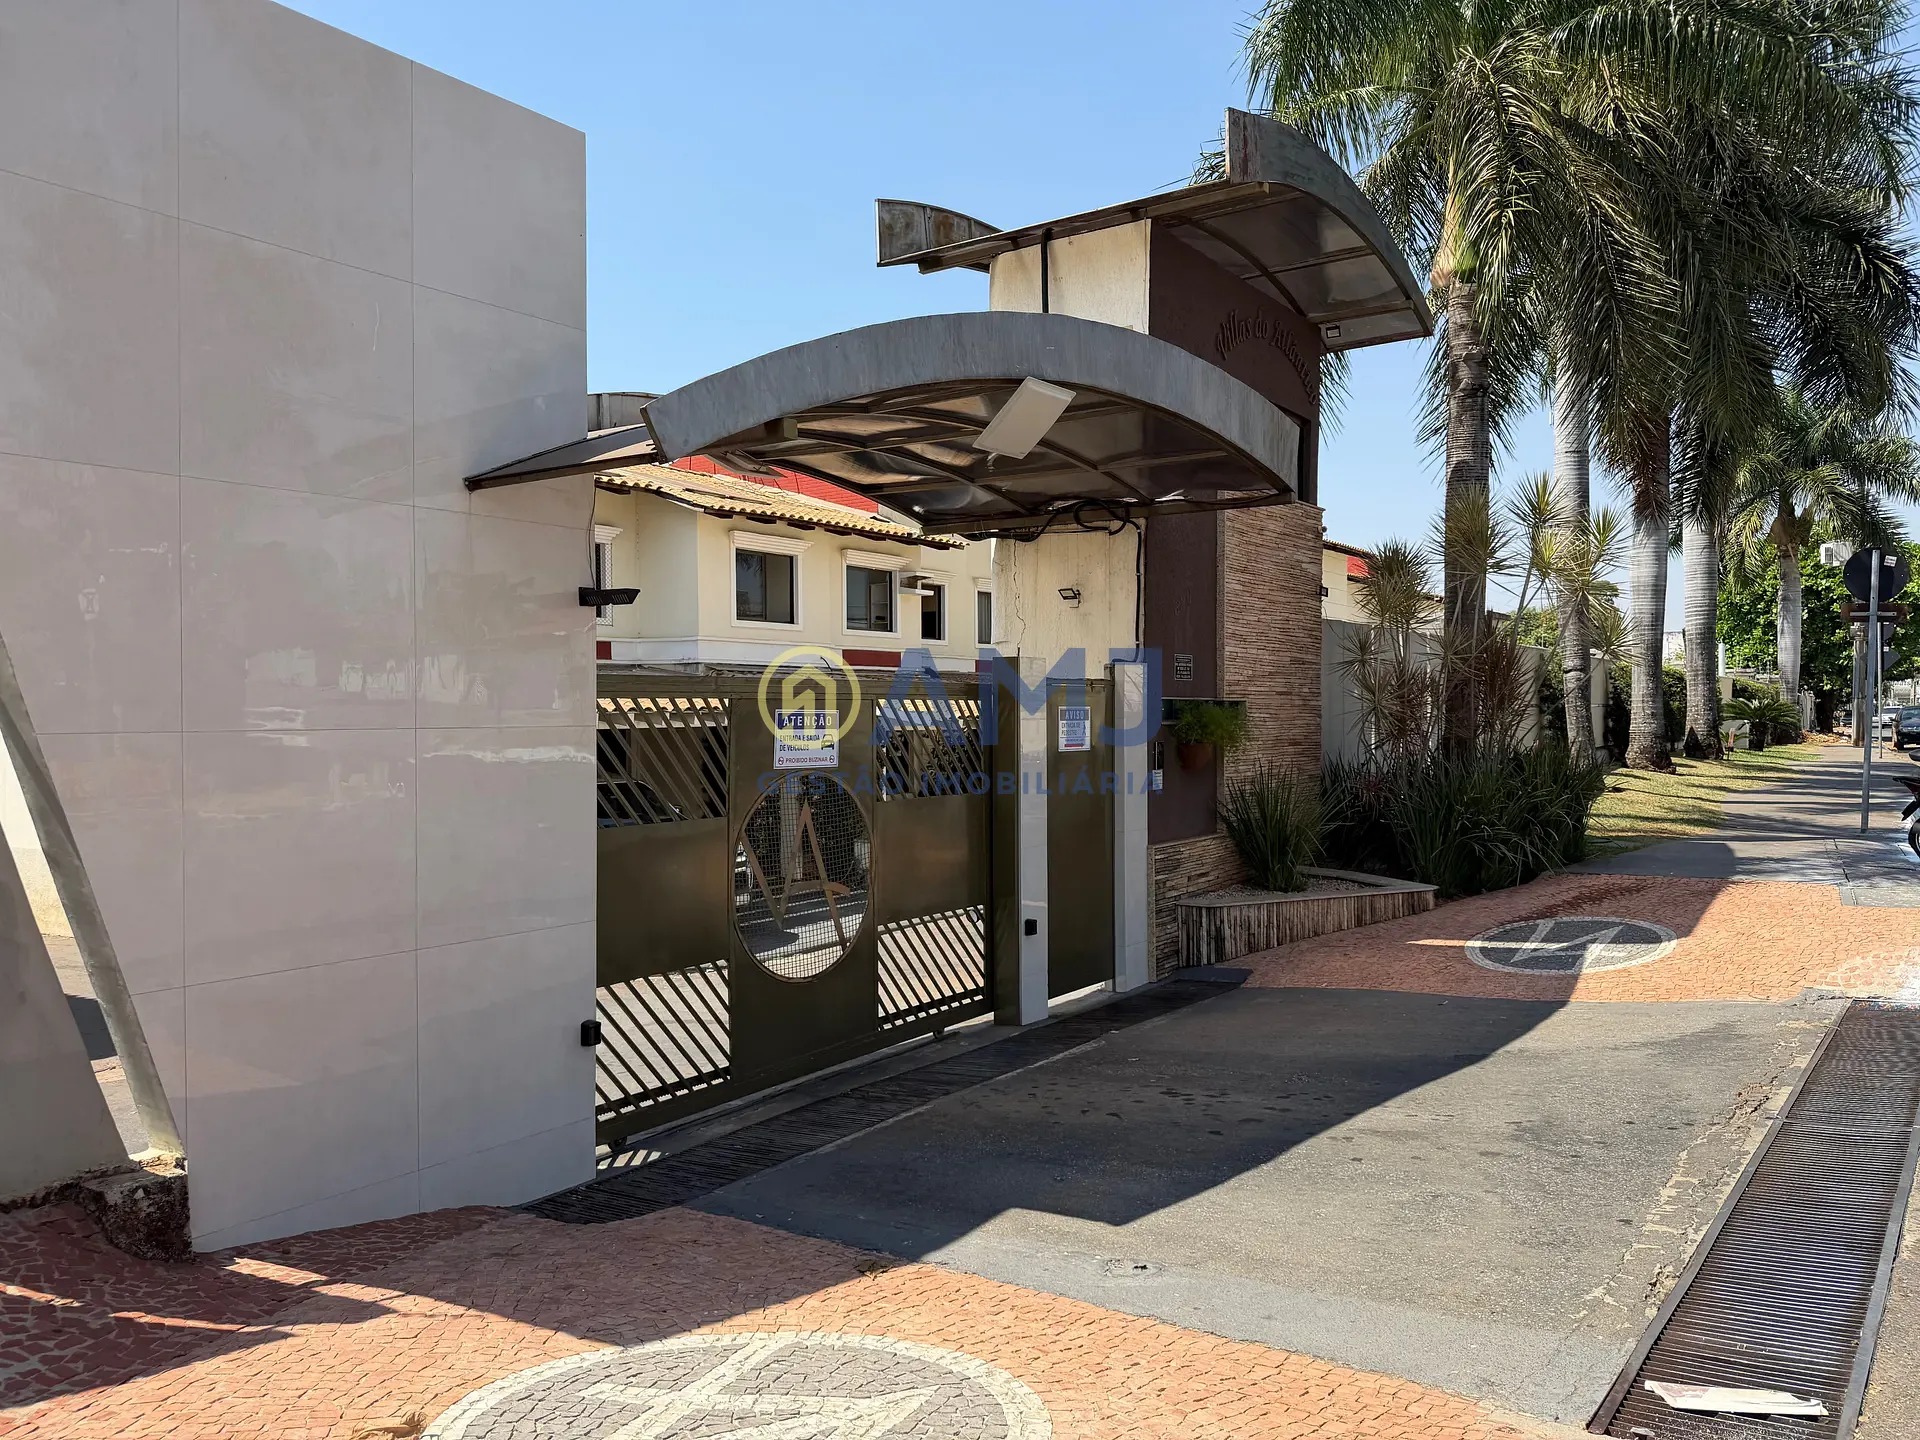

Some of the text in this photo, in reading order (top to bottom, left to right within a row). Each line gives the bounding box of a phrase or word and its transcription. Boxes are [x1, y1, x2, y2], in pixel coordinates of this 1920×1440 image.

[1256, 306, 1269, 339] do
[1065, 711, 1084, 719] AVISO
[783, 714, 832, 728] ATENÇÃO
[780, 734, 801, 742] ENTRADA
